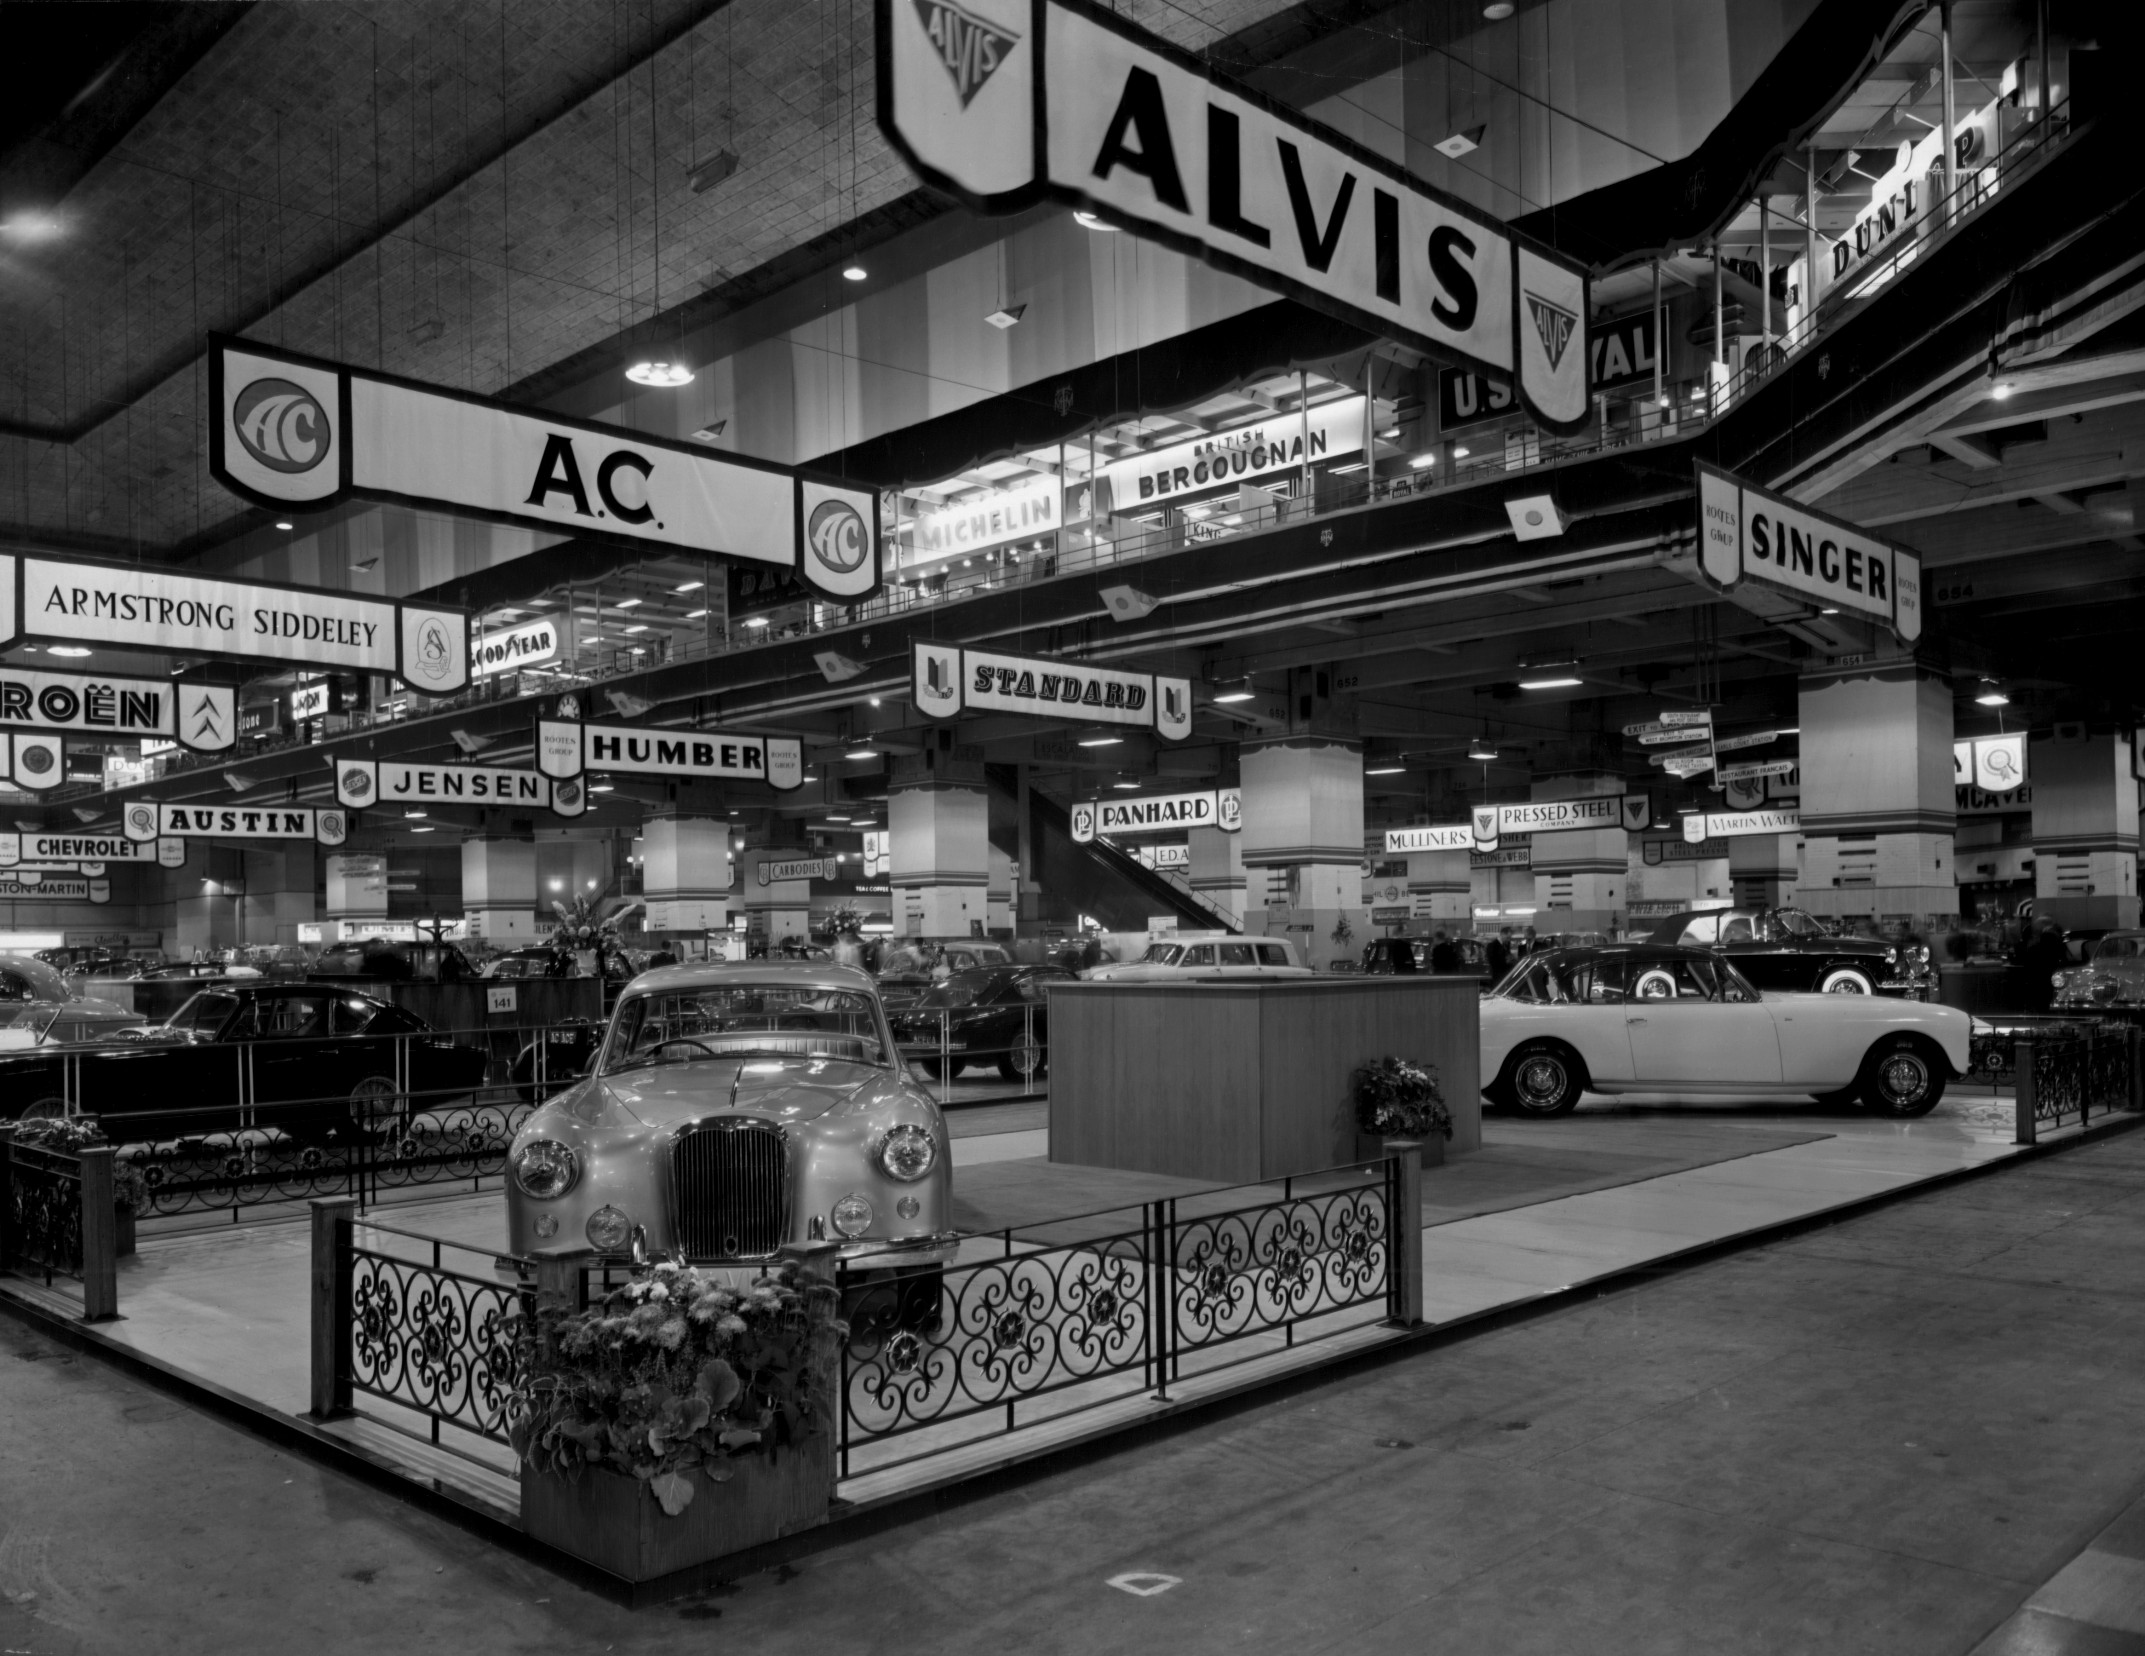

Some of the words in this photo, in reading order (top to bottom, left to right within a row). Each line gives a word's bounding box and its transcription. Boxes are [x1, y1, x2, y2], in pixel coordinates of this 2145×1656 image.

[928, 5, 1000, 96] ALVIS
[1091, 65, 1478, 332] ALVIS
[1536, 304, 1569, 362] ALVIS
[1194, 428, 1264, 457] BRITISH
[1139, 428, 1327, 499] BERGOUGNAN
[524, 433, 665, 530] A.C.
[921, 495, 1051, 550] MICHELIN
[1751, 512, 1887, 602] SINGER
[45, 584, 235, 631] ARMSTRONG
[254, 609, 378, 648] SIDDELEY
[1842, 656, 1860, 666] 654
[973, 665, 1147, 711] STANDARD
[544, 736, 576, 745] ROOTES
[1628, 725, 1647, 734] EXIT
[1752, 735, 1773, 744] STATION
[593, 735, 762, 770] HUMBER
[1720, 768, 1759, 779] RESTAURANT
[1760, 764, 1789, 774] FRANCAIS
[393, 771, 538, 799] JENSEN
[169, 809, 305, 833] AUSTIN
[1103, 798, 1210, 827] PANHARD
[1504, 805, 1568, 824] PRESSED
[1572, 801, 1616, 819] STEEL
[1540, 820, 1576, 828] COMPANY
[1711, 817, 1757, 831] MARTIN
[37, 839, 139, 857] CHEVROLET
[1389, 830, 1468, 851] MULLINERS
[1507, 851, 1528, 862] WEBB
[773, 861, 822, 878] CARBODIES
[855, 885, 865, 893] TEA
[869, 885, 889, 893] COFFEE
[493, 997, 511, 1009] 141
